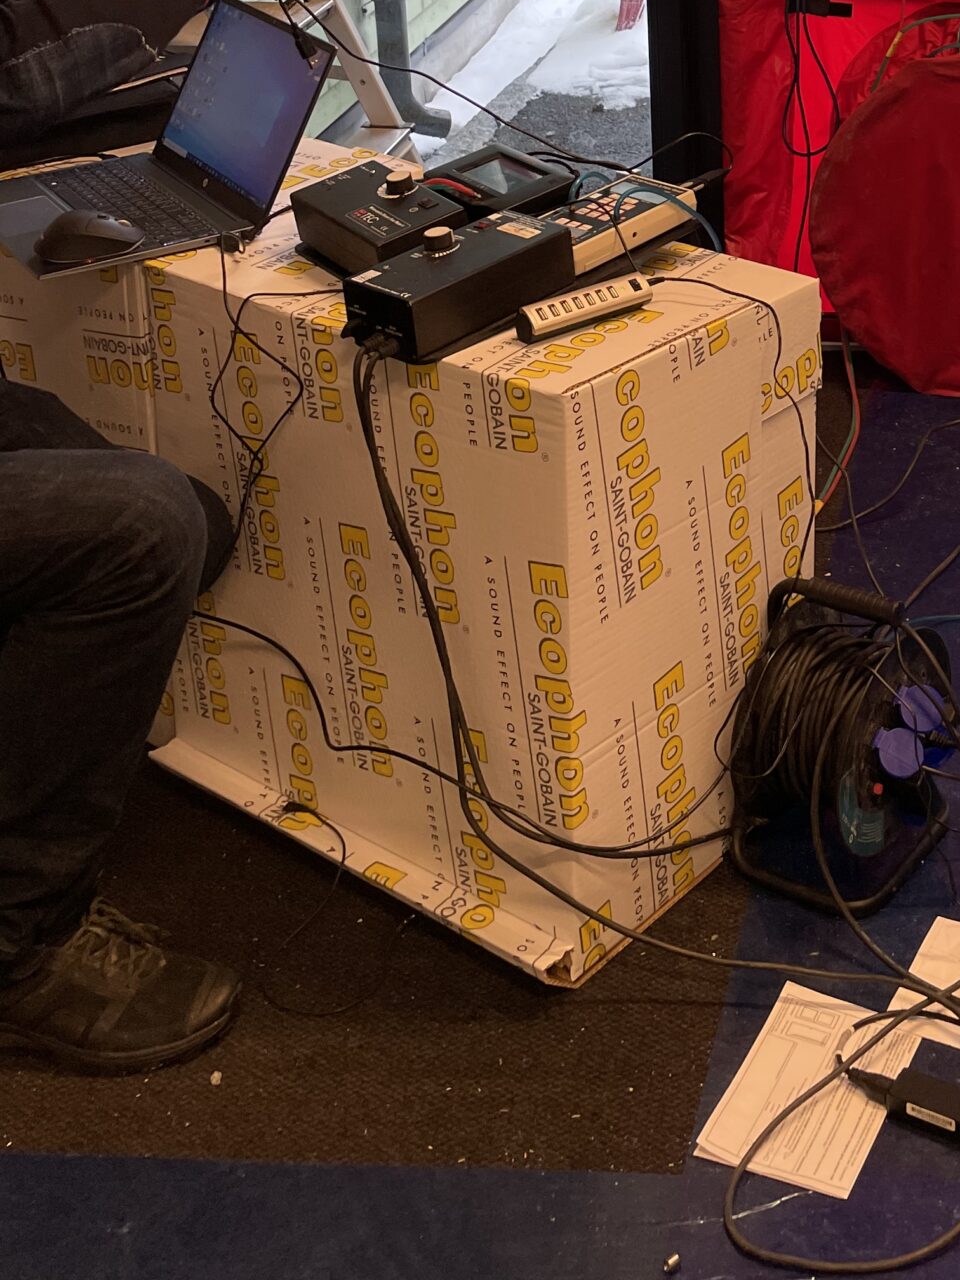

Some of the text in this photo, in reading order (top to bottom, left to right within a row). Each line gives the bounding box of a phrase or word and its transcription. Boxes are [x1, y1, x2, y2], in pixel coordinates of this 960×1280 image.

[201, 348, 214, 402] SOUN
[463, 382, 478, 446] PEOPLE
[504, 308, 664, 453] Ecophon
[668, 344, 681, 383] OPLE
[230, 330, 286, 580] Ecophon
[406, 362, 461, 624] Ecophon
[570, 391, 609, 624] SOUND EFFECT ON PEOPLE
[616, 369, 664, 590] cophon
[390, 552, 406, 616] PEOPLE
[610, 475, 637, 604] SAINT-GOBAIN
[685, 479, 716, 708] A SOUND EFFECT ON PEOPLE
[721, 432, 762, 674] Ecophon
[188, 622, 211, 719] INT-GOBAIN
[304, 517, 345, 765] A SOUND EFFECT ON PEOPE
[338, 521, 394, 778] Ecophon
[485, 556, 526, 809] A SOUND EFFECT ON PEOPL
[528, 560, 590, 830] Ecophon
[720, 571, 739, 689] SAINT-GOBAIN
[278, 673, 324, 831] Ecoph
[342, 645, 369, 771] SAINT-GOBIN
[527, 693, 557, 828] SAINT-GOBAIN
[613, 718, 623, 728] A
[615, 734, 630, 790] SOUND
[416, 735, 431, 794] SOND
[426, 804, 443, 863] EFFECT
[623, 795, 636, 843] EFFEC
[653, 660, 696, 895] Ecophon
[632, 886, 644, 923] PEOP
